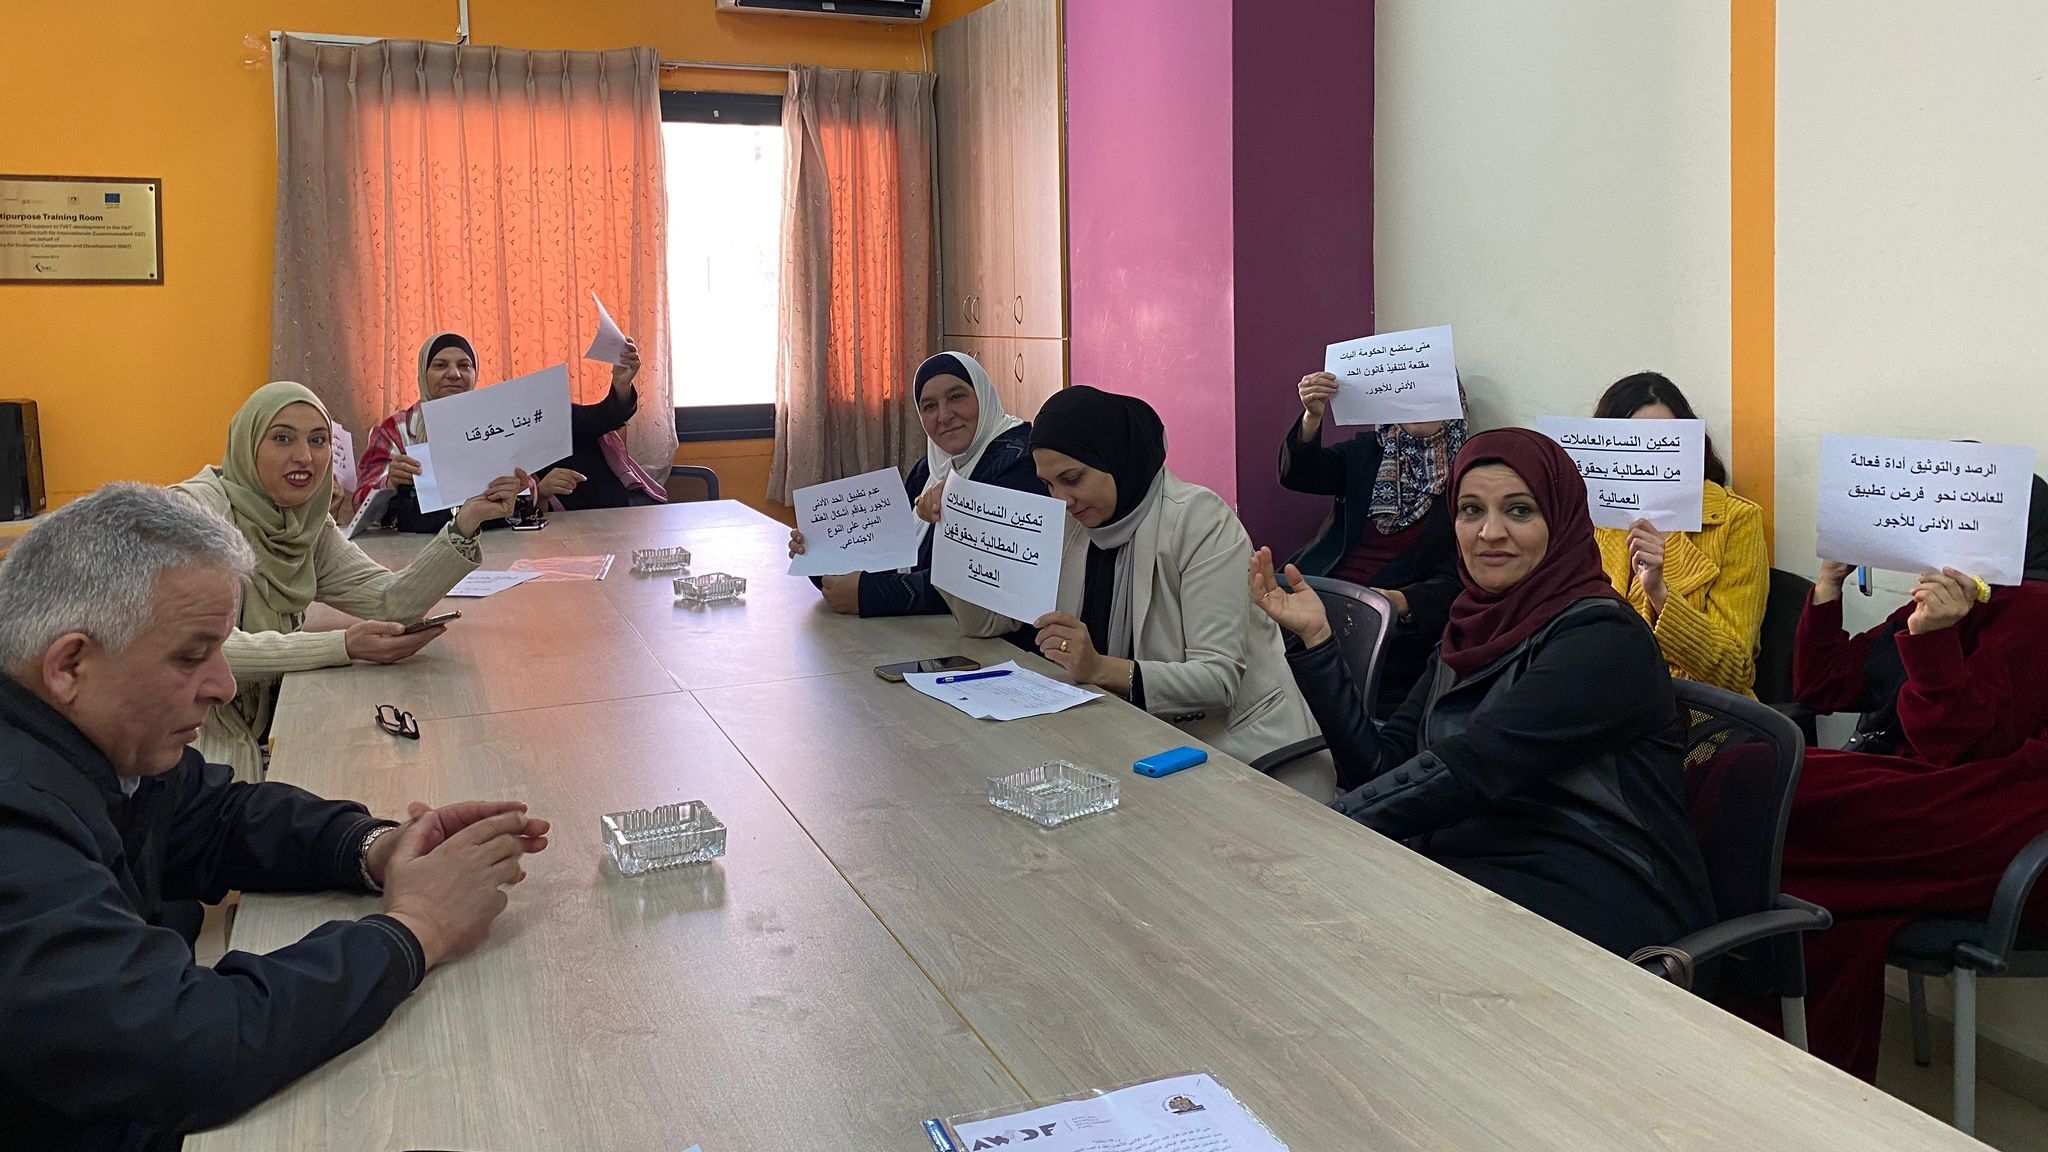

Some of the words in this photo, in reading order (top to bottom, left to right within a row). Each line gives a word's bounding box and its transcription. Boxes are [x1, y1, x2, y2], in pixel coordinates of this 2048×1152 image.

[42, 213, 77, 222] Training
[79, 213, 103, 221] Room
[1359, 346, 1387, 358] الحكومة
[1389, 344, 1413, 356] ستضع
[1415, 341, 1430, 353] متى
[1347, 368, 1361, 376] الحد
[1363, 364, 1384, 377] قانون
[1386, 362, 1407, 374] لتنفيذ
[1394, 380, 1416, 393] الأدنى
[1646, 436, 1681, 450] تمكين
[1850, 453, 1880, 468] فعالة
[1885, 456, 1906, 470] أداة
[1910, 457, 1960, 476] والتوثيق
[1612, 462, 1658, 479] المطالبة
[1663, 466, 1681, 479] من
[1964, 464, 1998, 478] الرصد
[846, 489, 866, 503] تطبيق
[868, 487, 880, 499] عدم
[1598, 489, 1640, 505] العمالية
[1848, 484, 1886, 498] تطبيق
[1890, 486, 1925, 502] فرض
[1934, 490, 1957, 504] نحو
[1960, 491, 2004, 504] للعاملات
[831, 494, 844, 504] الحد
[851, 503, 867, 517] يفاقم
[810, 512, 829, 523] العنف
[862, 515, 882, 530] المبني
[1010, 512, 1043, 527] تمكين
[1872, 512, 1915, 527] للأجور
[1918, 515, 1954, 533] الأدنى
[827, 524, 844, 538] النوع
[846, 521, 859, 534] على
[1958, 519, 1979, 531] الحد
[944, 522, 978, 546] بحقوقهن
[980, 531, 1018, 555] المطالبة
[1022, 547, 1039, 561] من
[968, 558, 1000, 583] العمالية
